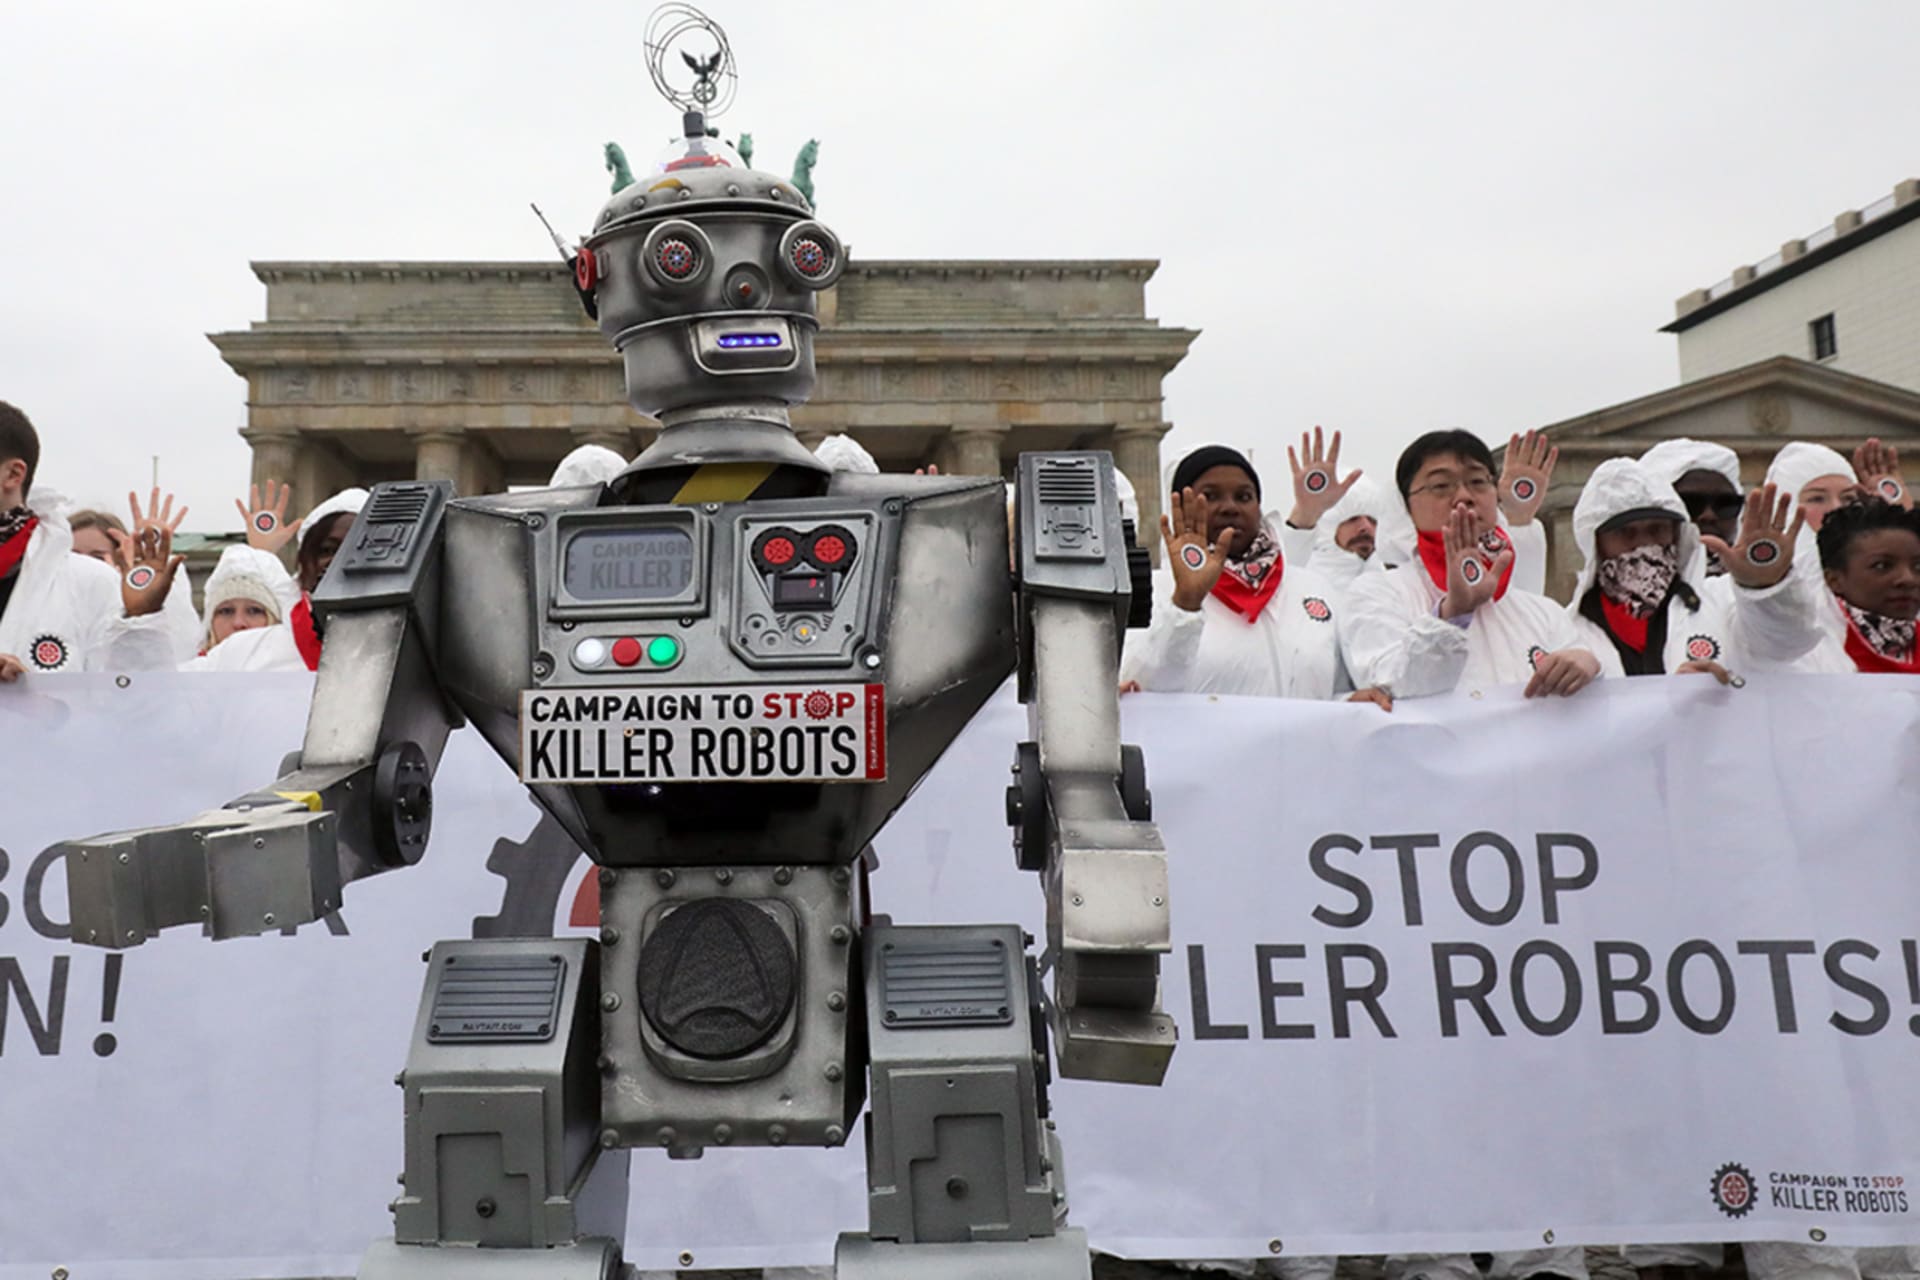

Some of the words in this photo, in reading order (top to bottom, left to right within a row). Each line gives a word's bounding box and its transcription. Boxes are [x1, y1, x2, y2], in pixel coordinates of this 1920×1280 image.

[592, 541, 692, 559] CAMPAIGN
[589, 559, 673, 590] KILLER
[530, 694, 701, 722] CAMPAIGN
[712, 694, 754, 720] TO
[763, 690, 856, 721] STOP
[530, 728, 674, 779] KILLER
[691, 725, 857, 778] ROBOTS
[1308, 831, 1600, 929] STOP
[1174, 942, 1398, 1041] LER
[1431, 937, 1920, 1038] ROBOTS!
[1769, 1172, 1848, 1188] CAMPAIGN
[1853, 1176, 1869, 1189] TO
[1872, 1175, 1905, 1189] STOP
[1771, 1186, 1840, 1213] KILLER
[1845, 1190, 1909, 1214] ROBOTS
